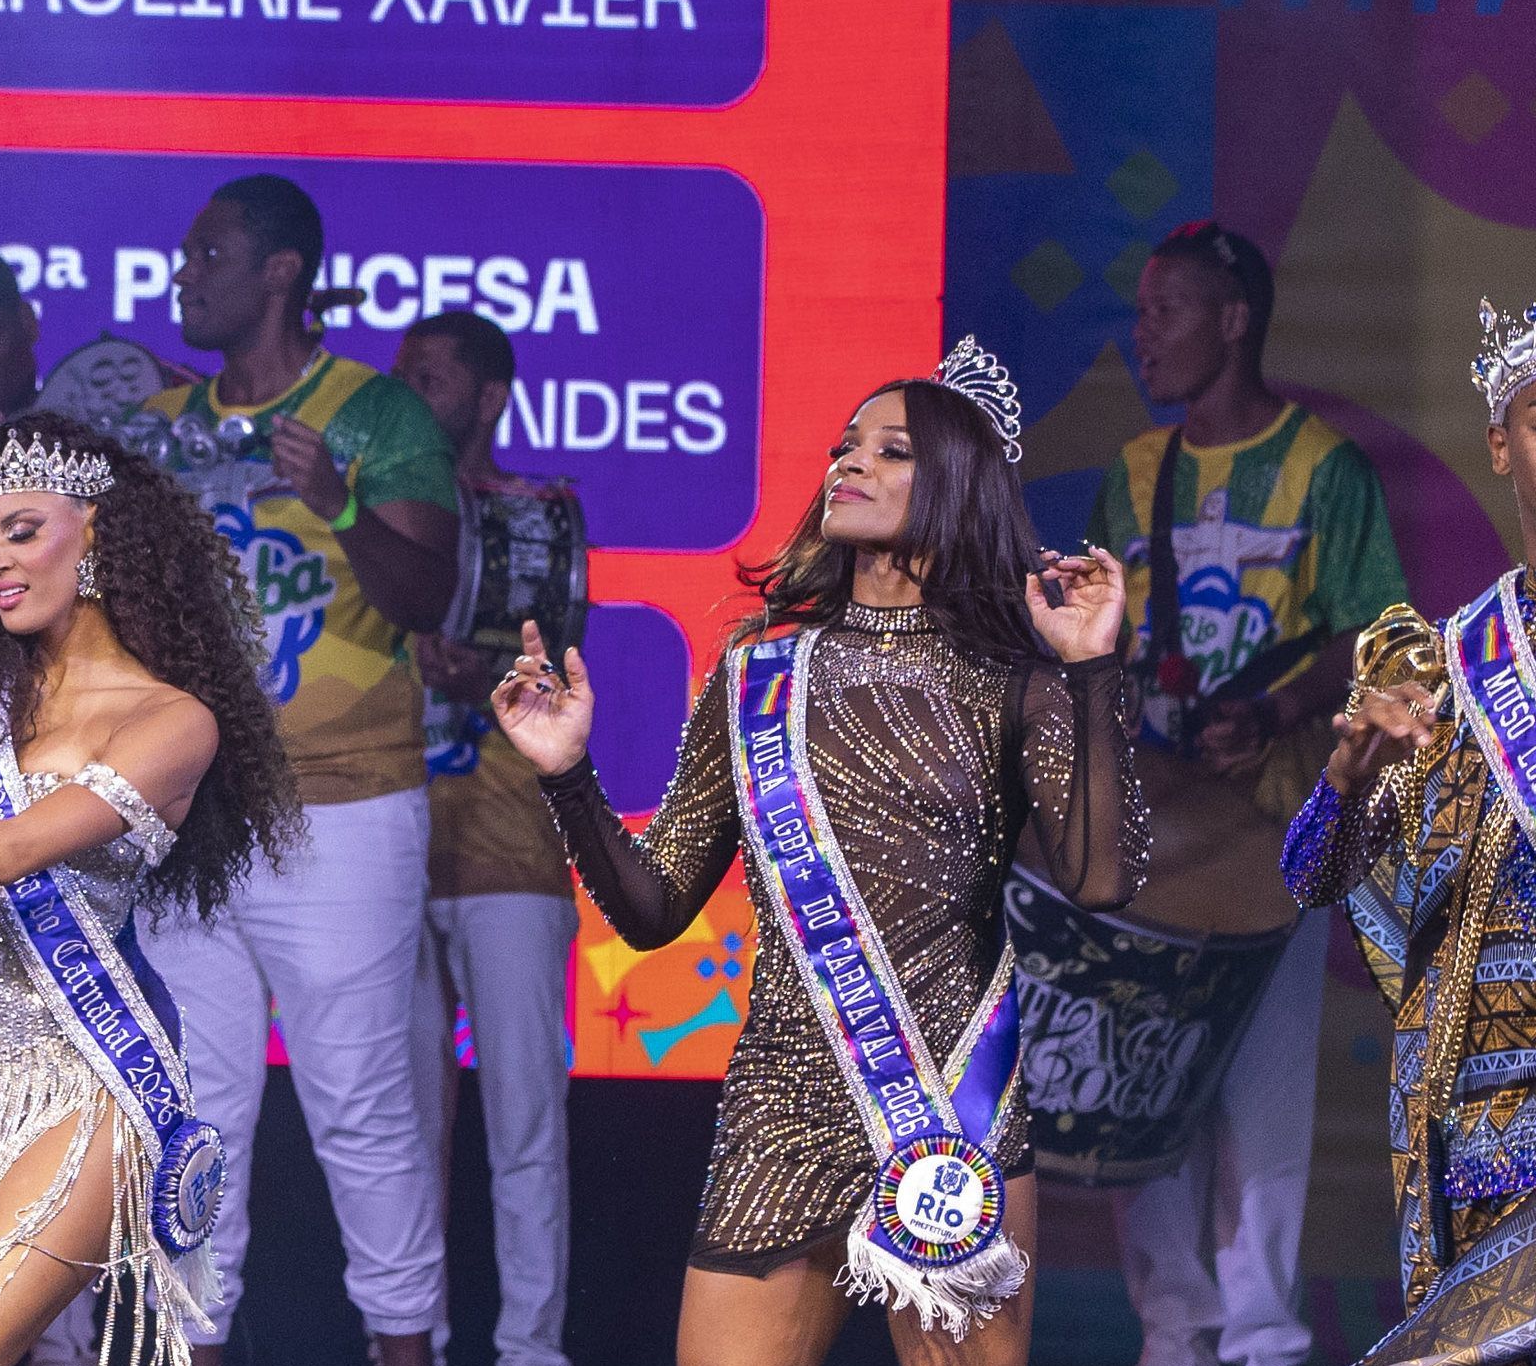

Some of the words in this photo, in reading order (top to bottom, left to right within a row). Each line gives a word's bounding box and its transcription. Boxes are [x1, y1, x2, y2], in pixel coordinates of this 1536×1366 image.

[498, 379, 728, 454] NDES
[1482, 663, 1536, 740] MUSO
[749, 724, 783, 798] MUSA
[769, 800, 814, 883] LGBT+
[800, 894, 833, 931] DO
[820, 935, 904, 1073] CARNAVAL
[879, 1074, 932, 1138] 2026
[30, 896, 60, 933] do
[52, 940, 145, 1061] Carnaval
[915, 1191, 964, 1228] Rio
